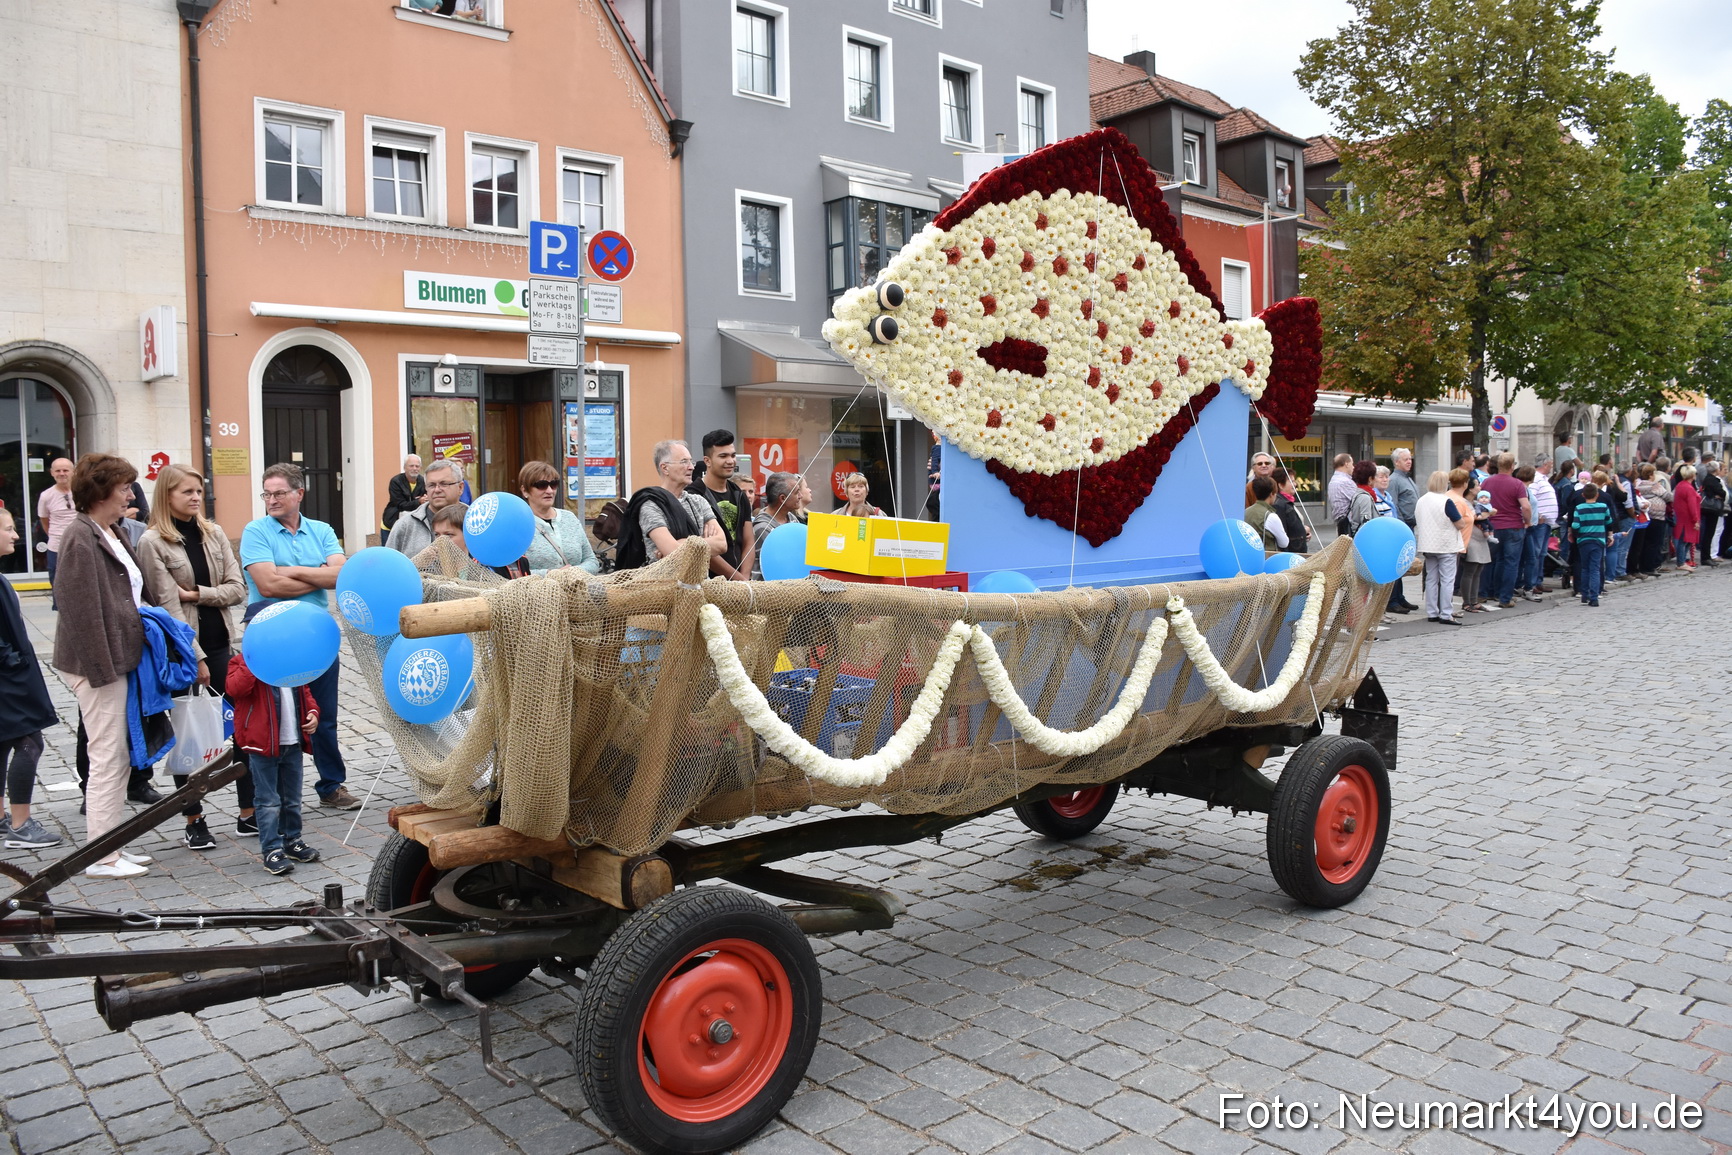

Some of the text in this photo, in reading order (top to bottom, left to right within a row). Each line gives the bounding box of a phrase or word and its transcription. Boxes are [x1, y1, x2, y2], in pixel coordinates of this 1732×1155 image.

[541, 228, 568, 269] P
[418, 279, 487, 305] Blumen
[555, 284, 568, 292] mit
[533, 290, 576, 302] Parkschein
[536, 301, 573, 311] werktags
[532, 319, 542, 328] Sa
[218, 422, 240, 436] 39
[401, 650, 448, 691] FISCHEREIVERBAND
[400, 682, 436, 705] OBERPFALZ
